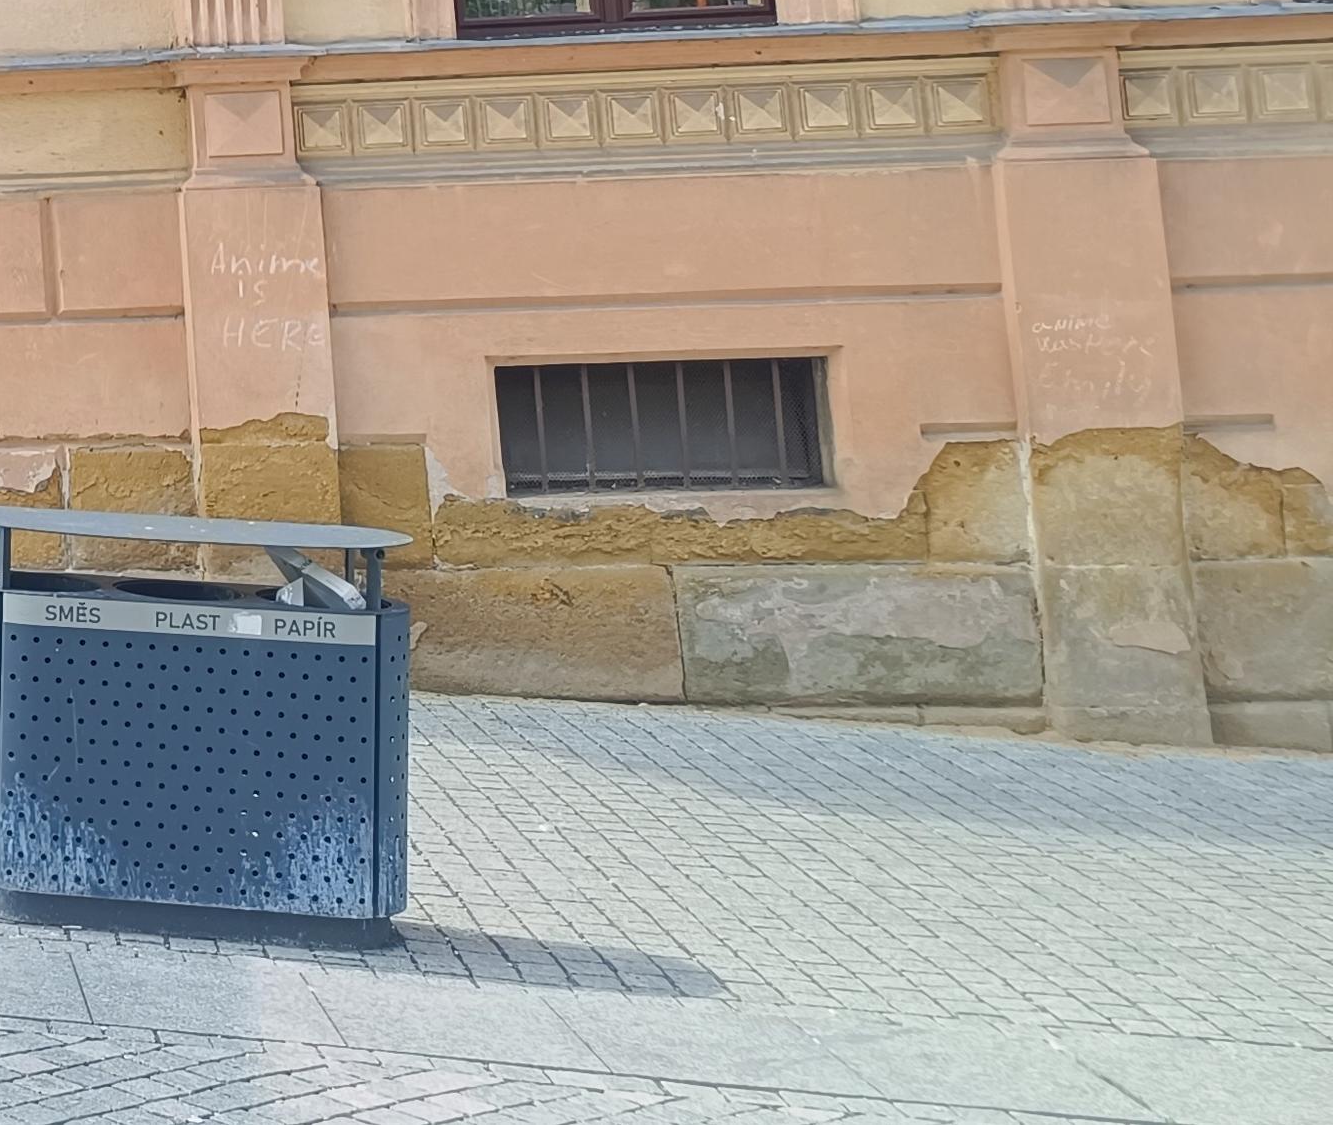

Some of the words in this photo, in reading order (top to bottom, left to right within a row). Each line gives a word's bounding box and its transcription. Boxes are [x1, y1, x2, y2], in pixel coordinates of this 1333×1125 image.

[44, 601, 101, 624] SMĚS
[154, 611, 220, 632] PLAST
[274, 616, 336, 639] PAPÍR
